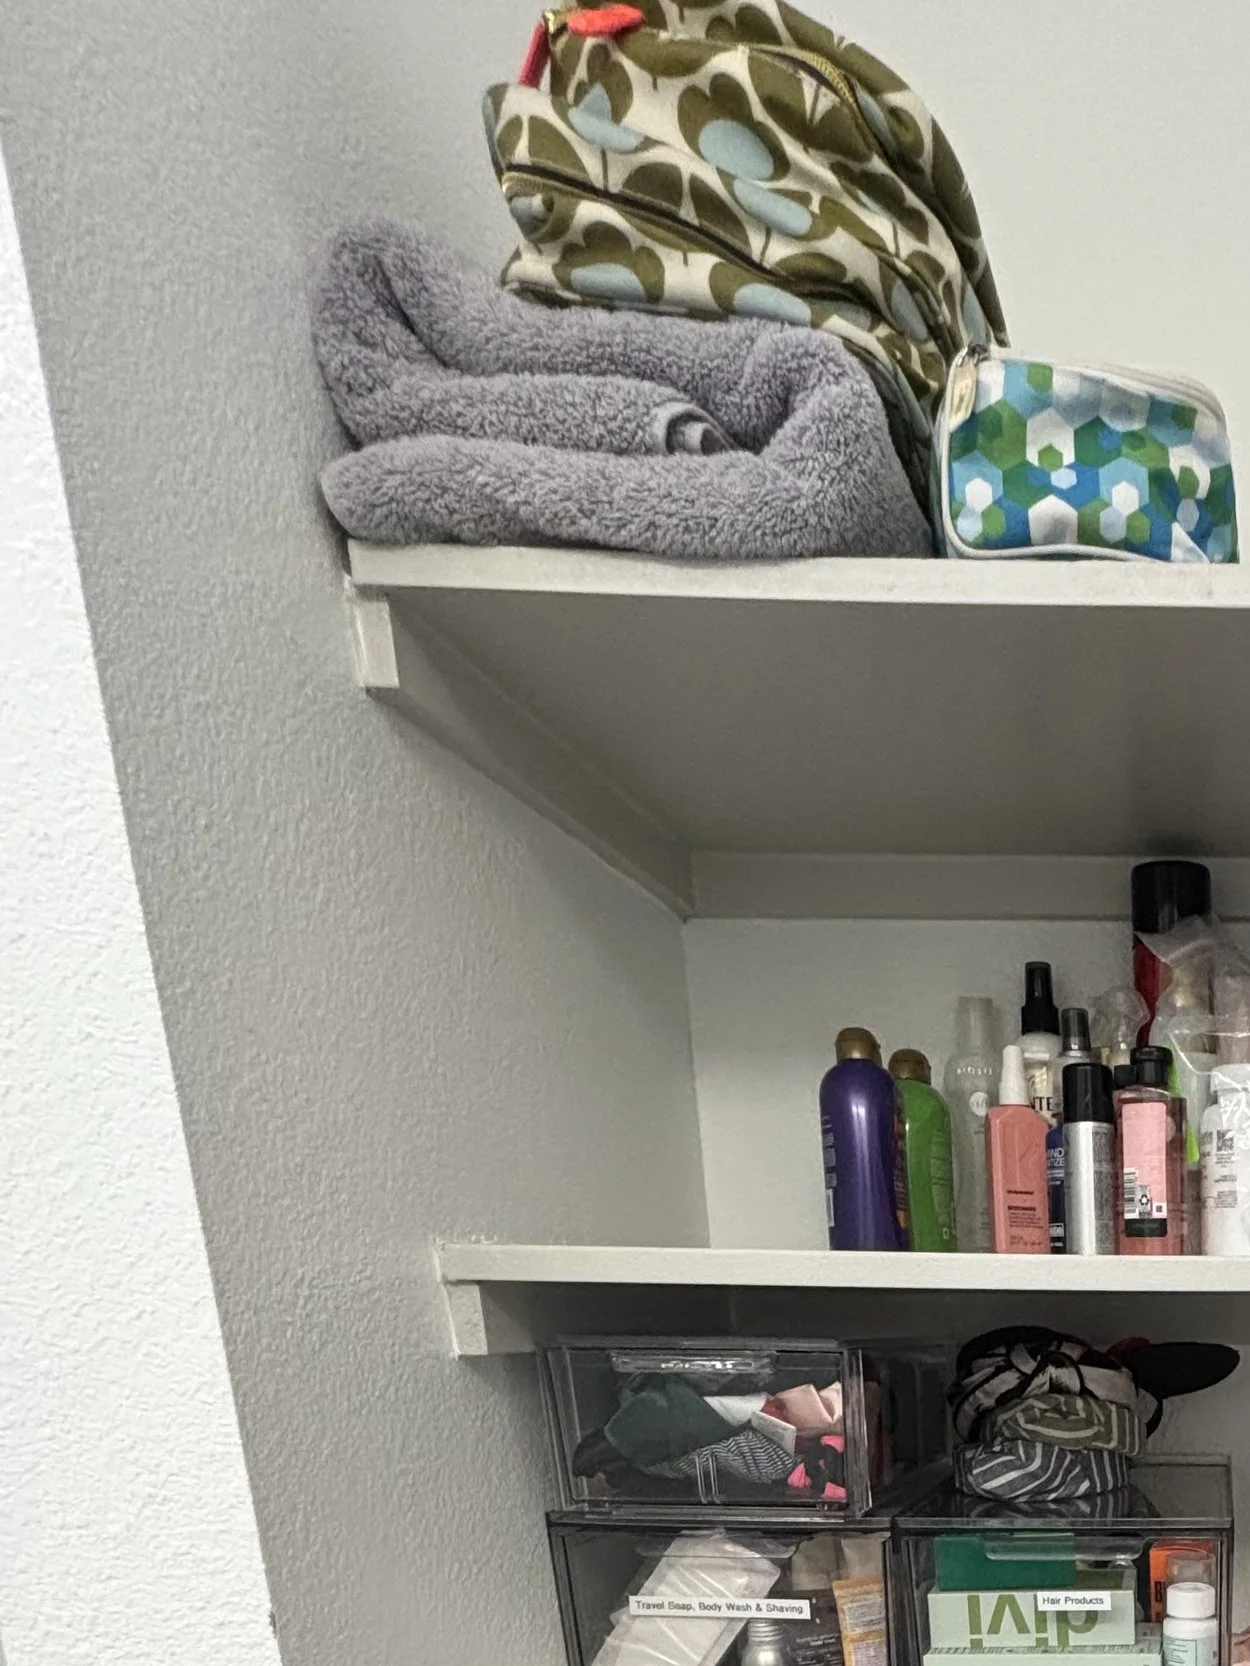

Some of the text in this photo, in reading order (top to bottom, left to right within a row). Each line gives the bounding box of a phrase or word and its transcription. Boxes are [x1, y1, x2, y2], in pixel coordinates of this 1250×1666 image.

[1042, 1596, 1104, 1606] Hair Products
[636, 1601, 803, 1614] Travel Soap, Body Wash & Shaving
